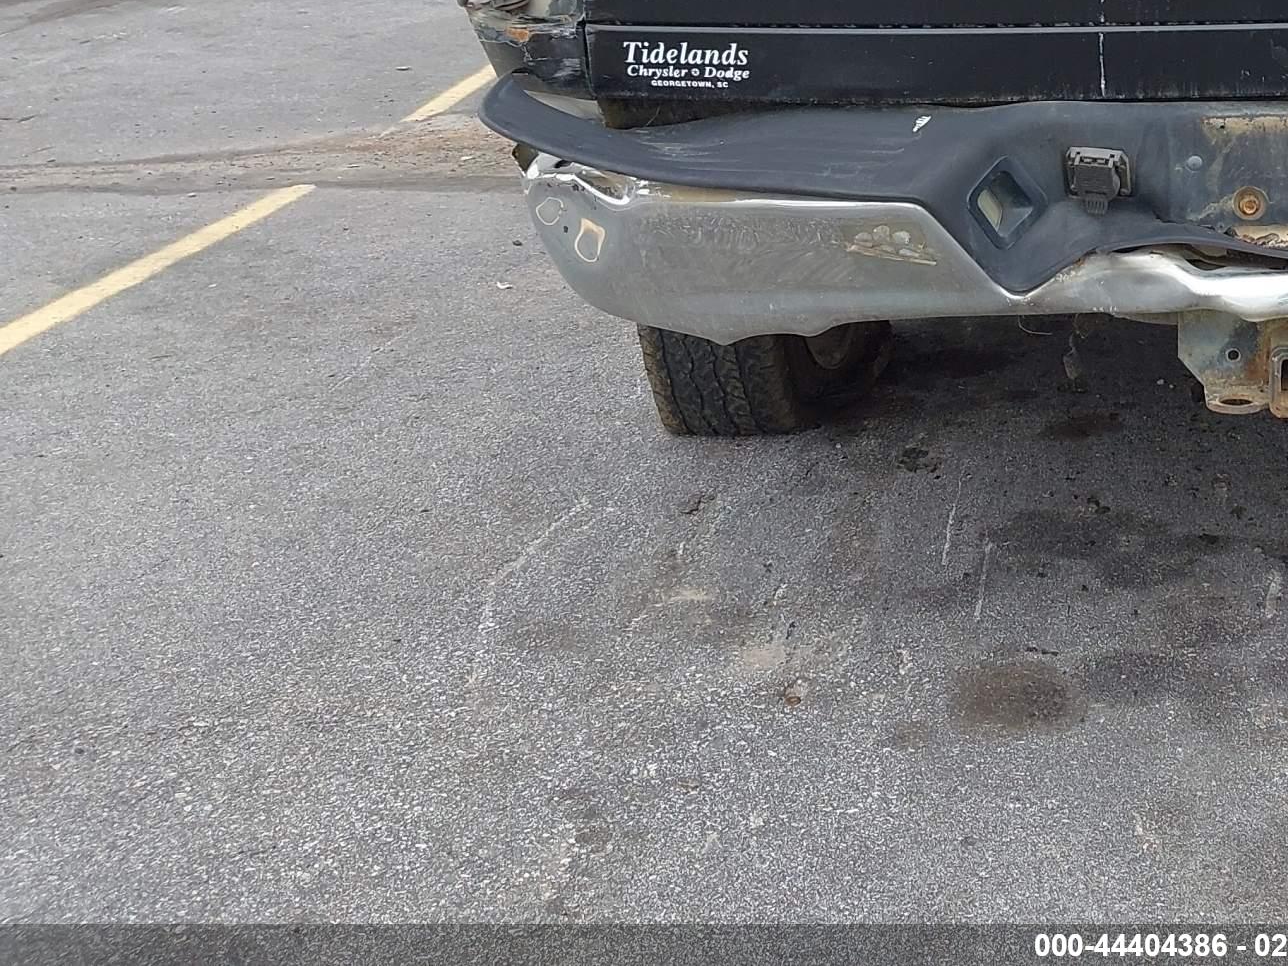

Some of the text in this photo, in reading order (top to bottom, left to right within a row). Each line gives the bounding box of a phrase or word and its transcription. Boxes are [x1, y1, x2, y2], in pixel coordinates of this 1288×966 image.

[623, 41, 749, 65] Tidelands
[627, 65, 750, 81] Chrysler Dodge
[651, 80, 715, 89] GEORGETOWN,
